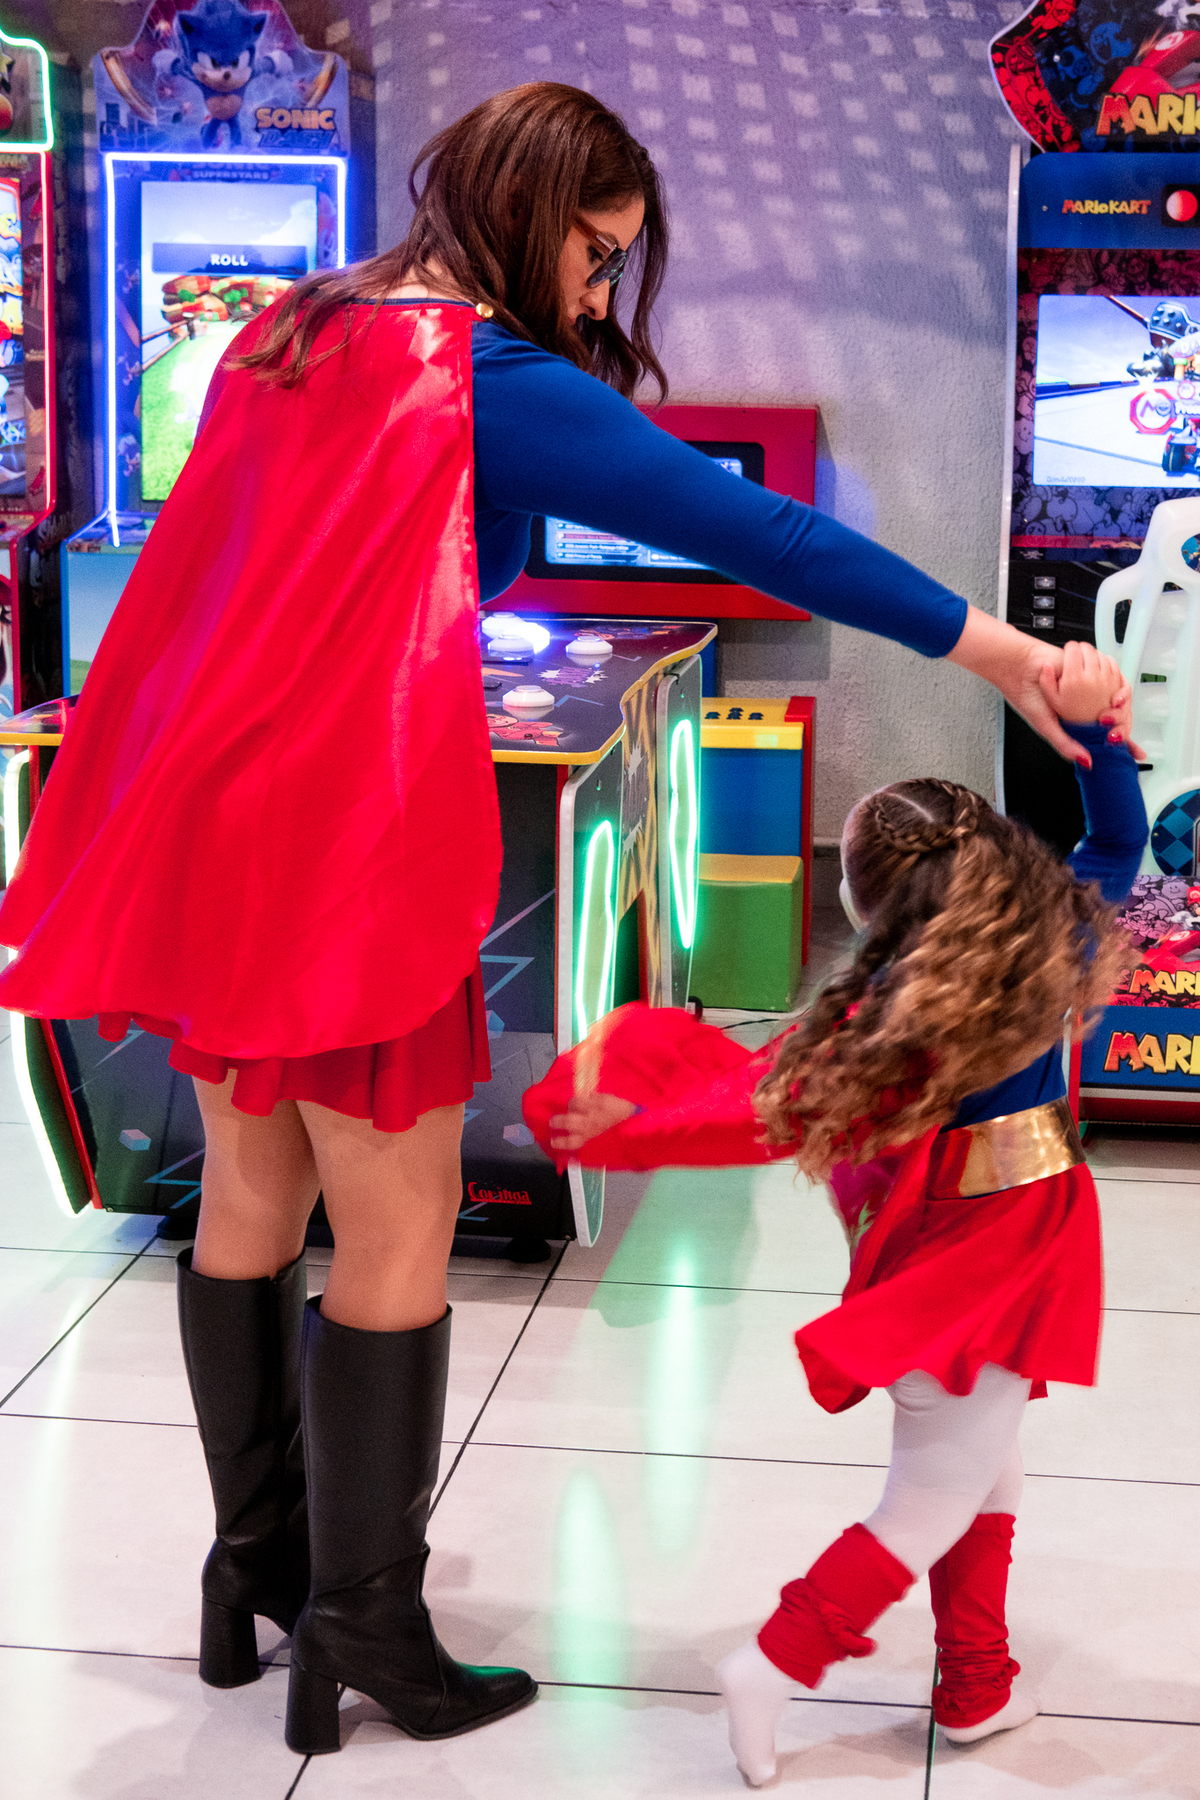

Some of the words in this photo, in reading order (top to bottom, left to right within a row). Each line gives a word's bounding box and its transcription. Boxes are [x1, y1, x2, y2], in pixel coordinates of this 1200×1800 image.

[256, 107, 335, 130] SONIC
[1096, 93, 1200, 135] MARI
[192, 170, 270, 180] SUPERSTARS
[210, 253, 249, 267] ROLL
[467, 1181, 532, 1206] Coringa
